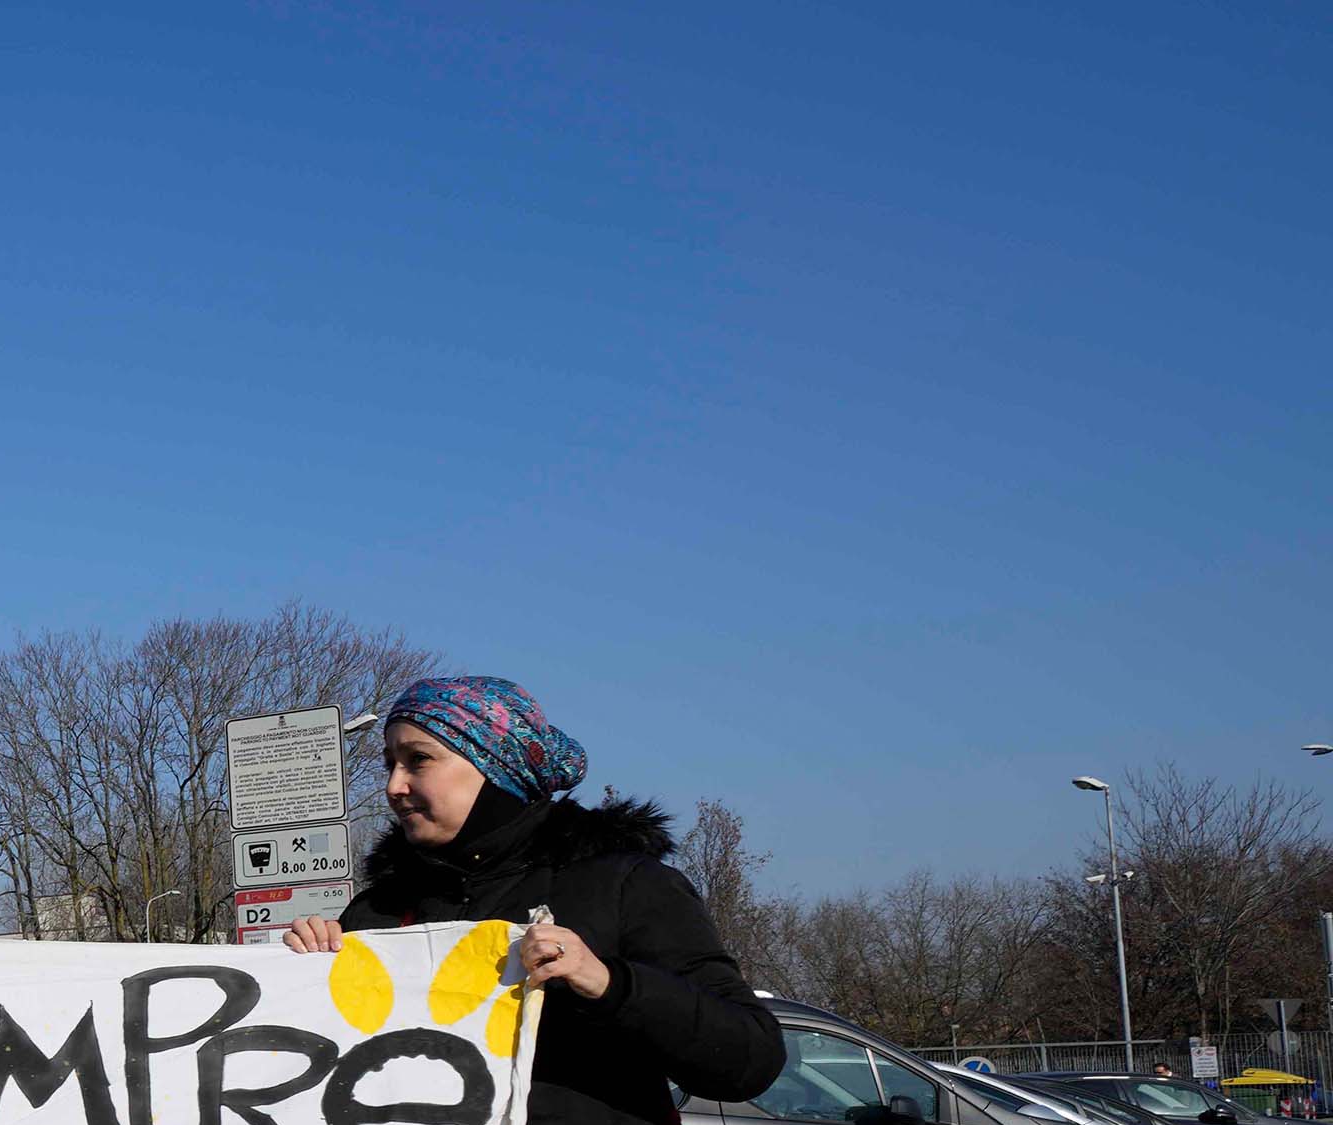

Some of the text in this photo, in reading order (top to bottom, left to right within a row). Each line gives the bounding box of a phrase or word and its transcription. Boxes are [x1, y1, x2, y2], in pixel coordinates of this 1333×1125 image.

[281, 857, 346, 874] 8.00 20.00
[323, 889, 343, 898] 0.50
[246, 907, 271, 924] D2
